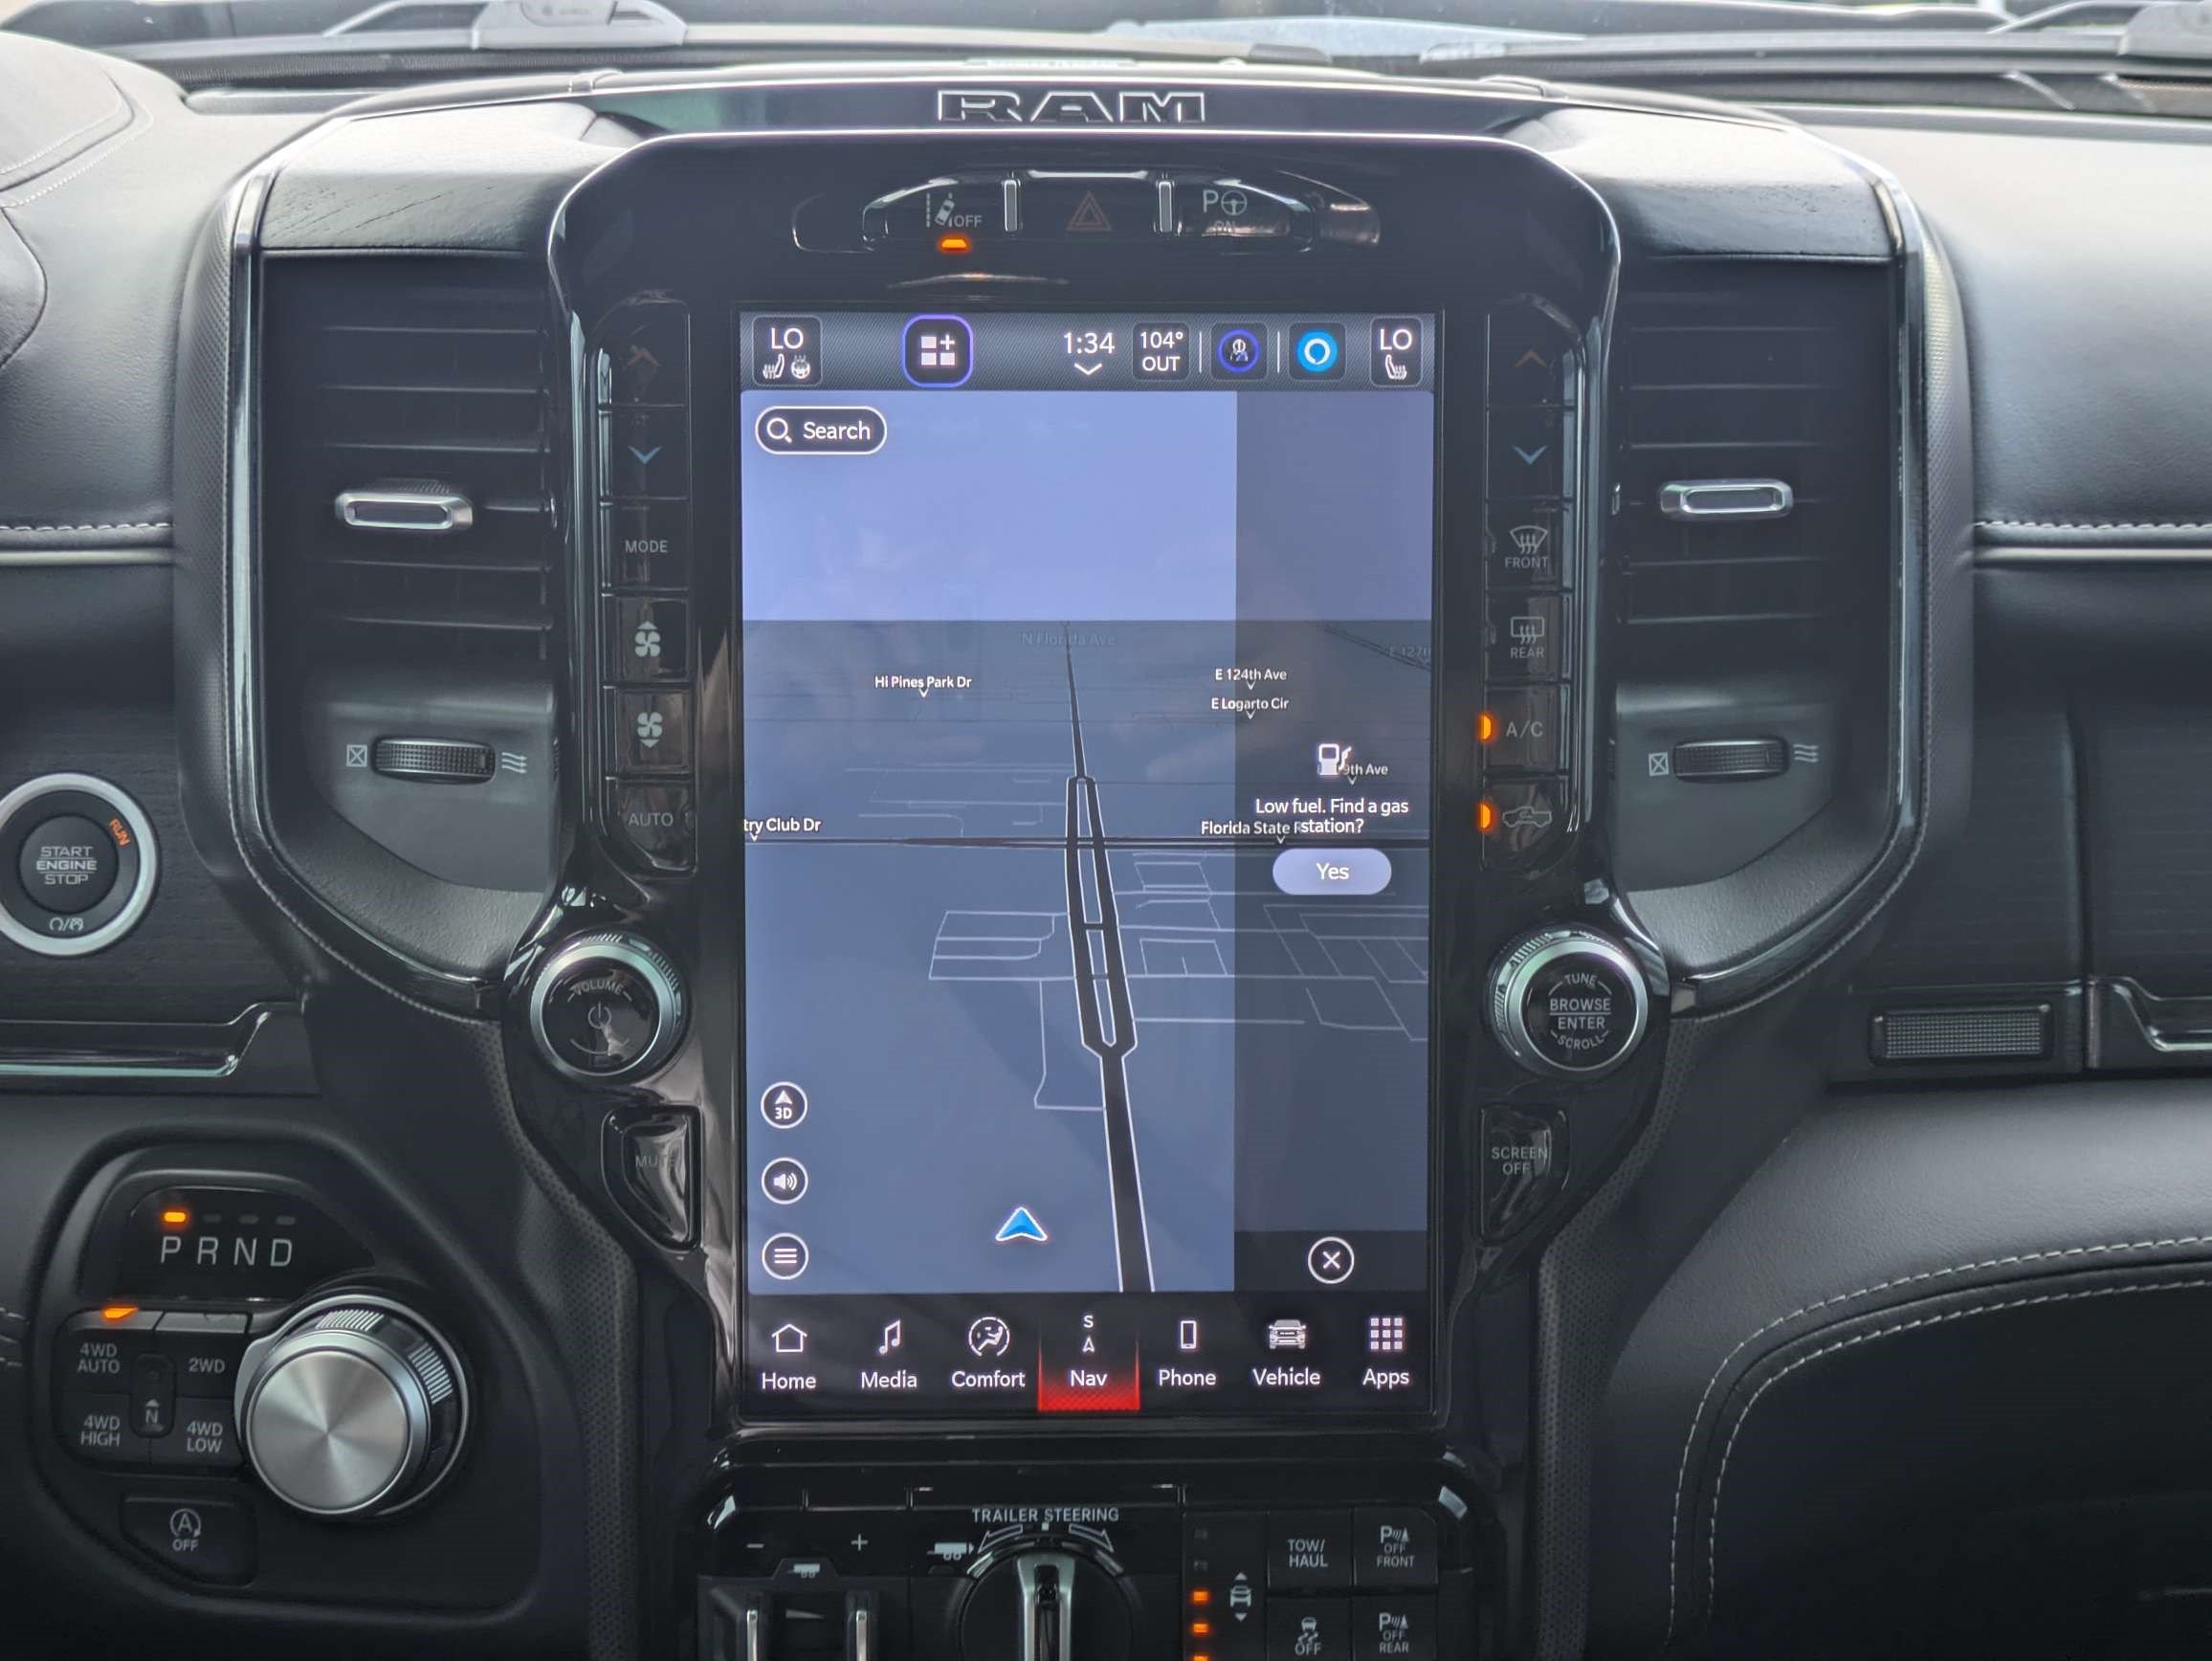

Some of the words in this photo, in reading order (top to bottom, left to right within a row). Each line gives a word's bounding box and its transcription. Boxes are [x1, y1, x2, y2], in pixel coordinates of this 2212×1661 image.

[937, 90, 1206, 123] RAM
[954, 214, 983, 229] OFF
[770, 327, 805, 351] LO
[1063, 332, 1116, 355] 1:34
[1380, 328, 1413, 351] LO
[1141, 356, 1181, 373] OUT
[803, 419, 872, 441] Search
[624, 540, 669, 554] MODE
[1504, 556, 1549, 569] FRONT
[1036, 631, 1086, 645] Florda
[1510, 647, 1545, 659] REAR
[874, 675, 889, 689] Hi
[891, 675, 924, 689] Pines
[926, 676, 955, 689] Park
[956, 676, 973, 689] Dr
[1214, 668, 1224, 681] E
[1226, 668, 1262, 681] 124th
[1263, 669, 1288, 681] Ave
[1211, 698, 1219, 710] E
[1221, 698, 1270, 713] Logarto
[1271, 698, 1290, 710] Cir
[1505, 720, 1544, 739] A/C
[1365, 764, 1389, 776] Ave
[1255, 798, 1290, 814] Low
[1292, 797, 1327, 814] fuel.
[1331, 798, 1365, 814] Find
[1367, 802, 1378, 814] a
[1380, 802, 1409, 817] gas
[628, 812, 675, 828] AUTO
[765, 817, 801, 833] Club
[803, 818, 822, 833] Dr
[1201, 820, 1250, 834] Florida
[1253, 821, 1291, 834] State
[1300, 817, 1365, 834] station?
[109, 818, 131, 848] RUN
[39, 845, 94, 858] START
[35, 858, 98, 872] ENGINE
[1316, 862, 1350, 880] Yes
[43, 873, 90, 886] STOP
[572, 977, 625, 995] VOLUME
[1563, 972, 1598, 988] TUNE
[1549, 998, 1612, 1012] BROWSE
[1558, 1017, 1605, 1030] ENTER
[1557, 1033, 1606, 1051] SCROLL
[775, 1107, 793, 1120] 3D
[1491, 1147, 1549, 1161] SCREEN
[1502, 1163, 1532, 1176] OFF
[161, 1235, 183, 1265] P
[197, 1236, 220, 1266] R
[233, 1237, 258, 1267] N
[269, 1238, 294, 1268] D
[79, 1342, 118, 1359] 4WD
[77, 1359, 121, 1375] AUTO
[188, 1358, 226, 1375] 2WD
[761, 1370, 817, 1391] Home
[860, 1369, 918, 1390] Media
[951, 1368, 1027, 1390] Comfort
[1070, 1369, 1108, 1388] Nav
[1158, 1368, 1217, 1387] Phone
[1251, 1366, 1321, 1387] Vehicle
[1361, 1368, 1410, 1391] Apps
[82, 1414, 122, 1431] 4WD
[145, 1408, 159, 1425] N
[187, 1421, 223, 1437] 4WD
[80, 1431, 121, 1448] HIGH
[187, 1438, 223, 1453] LOW
[972, 1507, 1039, 1523] TRAILER
[1044, 1506, 1119, 1522] STEERING
[172, 1539, 199, 1553] OFF
[1288, 1538, 1326, 1553] TOW/
[1383, 1543, 1407, 1554] OFF
[1289, 1555, 1329, 1568] HAUL
[1377, 1555, 1415, 1568] FRONT
[1382, 1629, 1406, 1641] OFF
[1294, 1643, 1321, 1656] OFF
[1379, 1642, 1410, 1654] REAR
